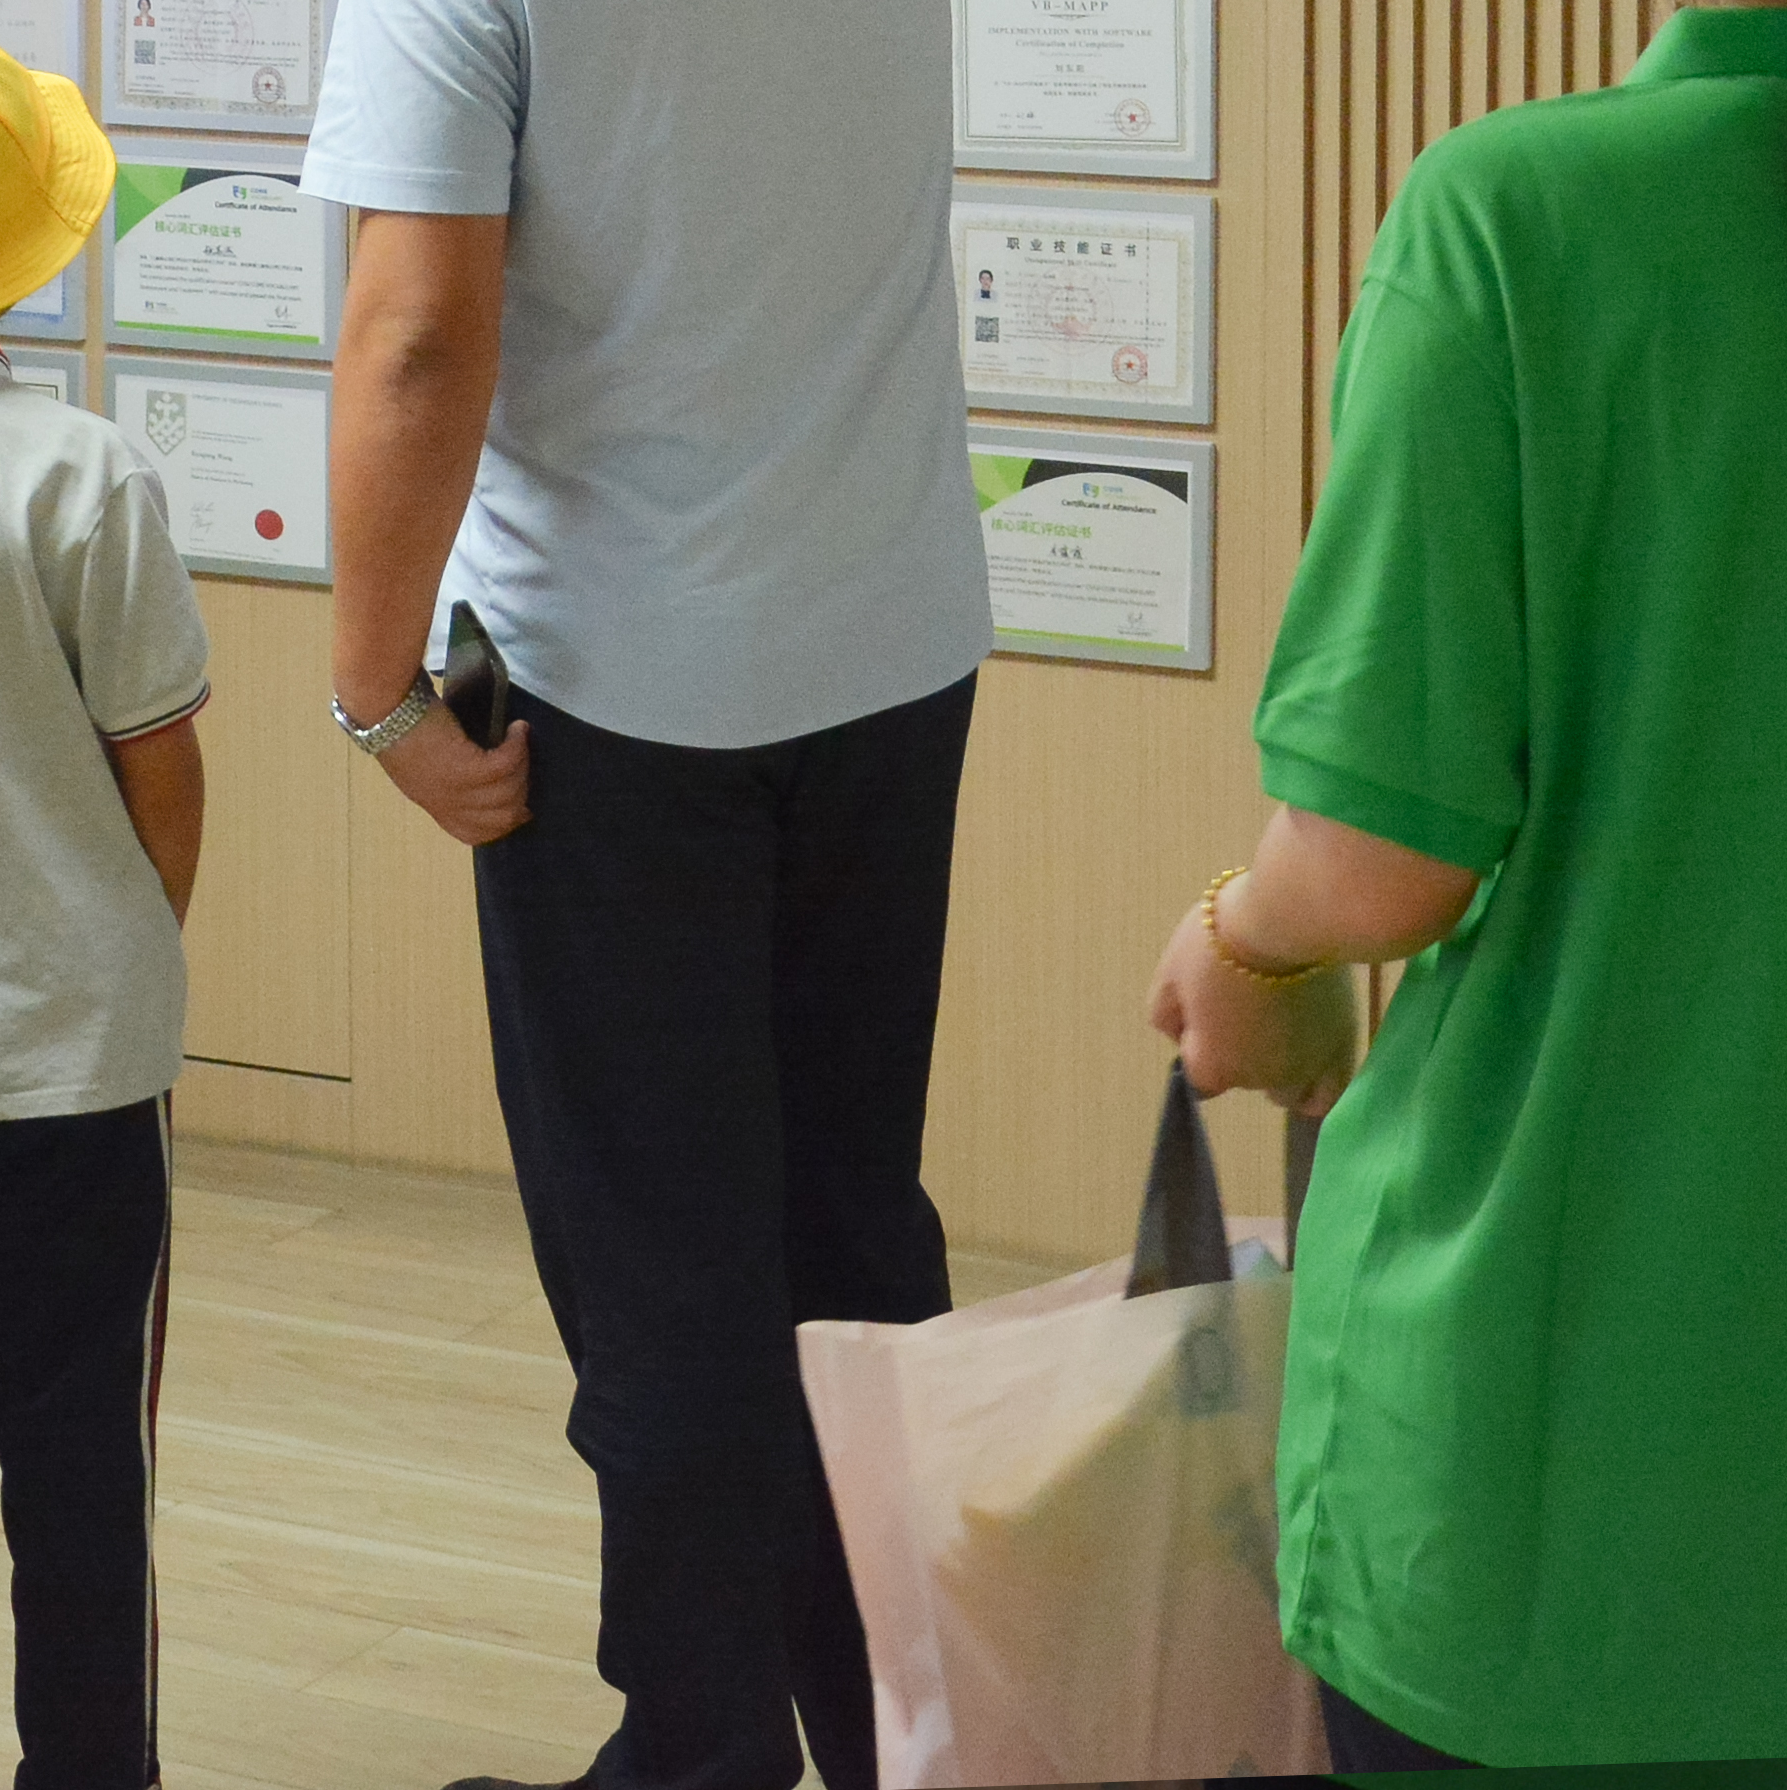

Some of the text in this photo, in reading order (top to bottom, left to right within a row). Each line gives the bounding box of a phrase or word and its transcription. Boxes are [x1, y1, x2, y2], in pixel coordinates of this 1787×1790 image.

[1030, 0, 1110, 12] VB-MAPP
[214, 200, 249, 211] Certificate
[258, 204, 298, 214] Attendance
[154, 219, 242, 239] 核心词汇评估证书
[1005, 235, 1138, 258] 职业技能证书
[1061, 498, 1101, 511] Certificate
[1111, 502, 1157, 515] Attendance
[991, 516, 1092, 539] 核心词汇评估证书
